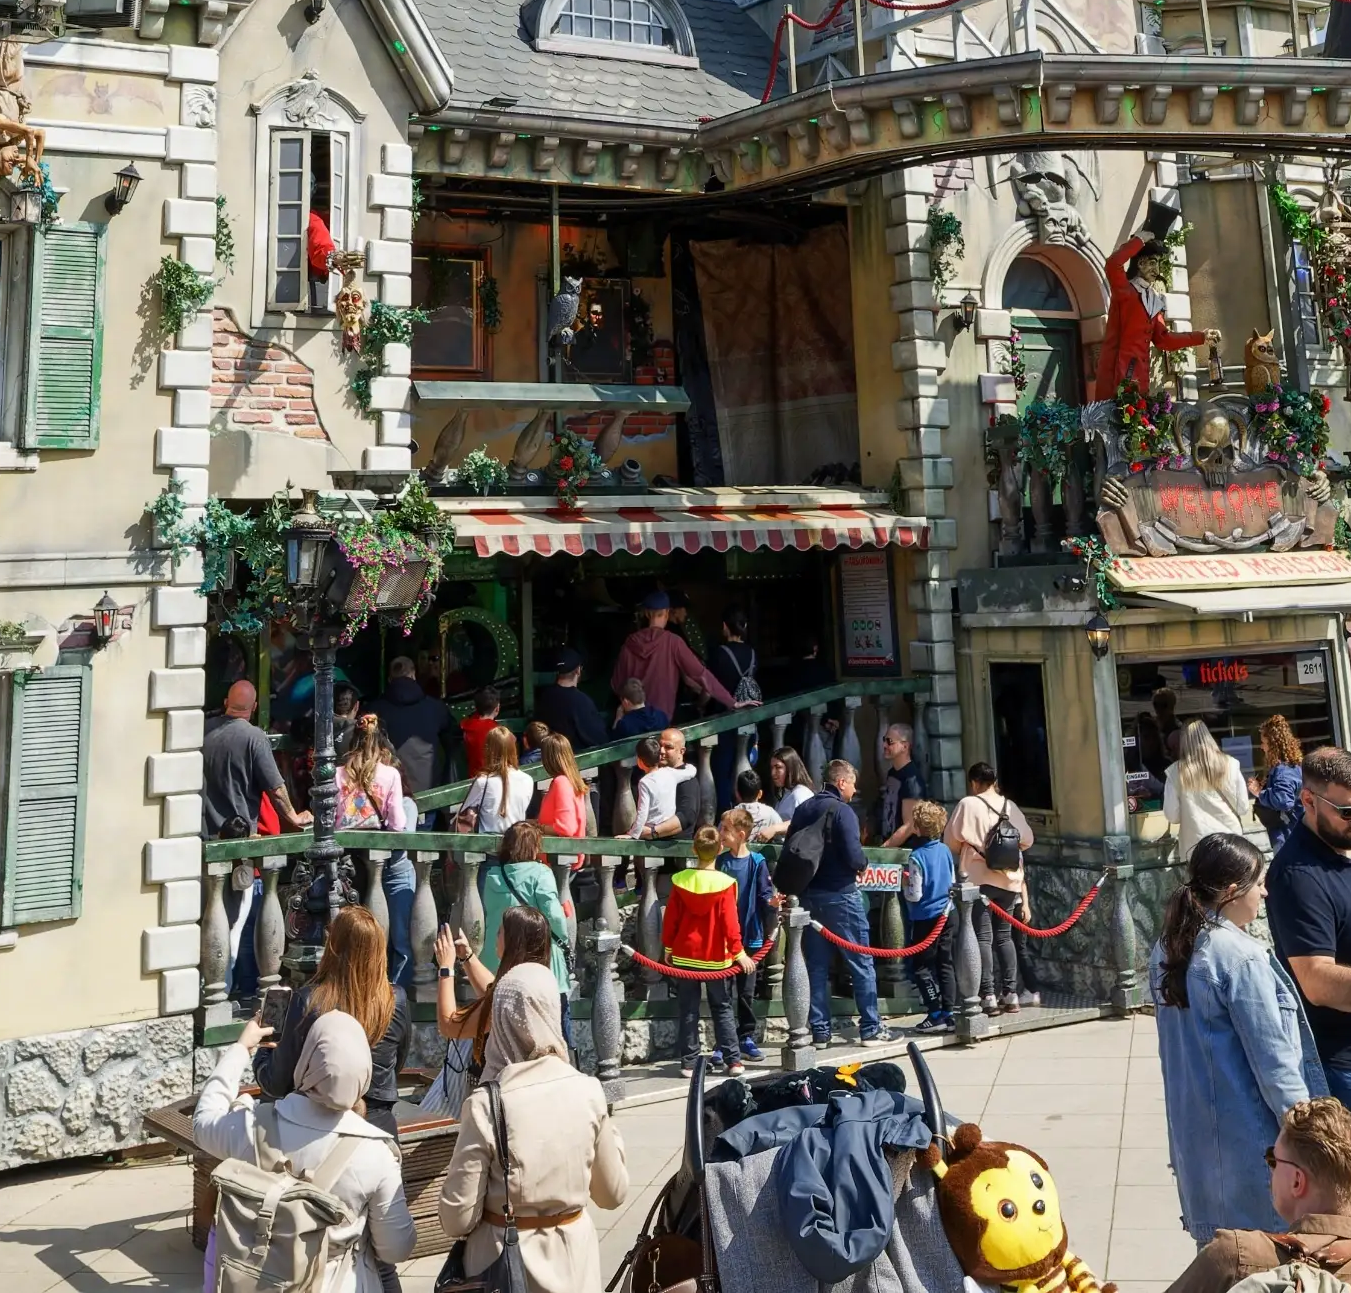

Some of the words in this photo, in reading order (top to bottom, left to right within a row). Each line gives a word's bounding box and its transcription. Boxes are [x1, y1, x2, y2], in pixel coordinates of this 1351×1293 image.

[1159, 480, 1283, 531] WELCOME
[1122, 557, 1241, 582] HAUNTED
[1303, 662, 1323, 675] 2611
